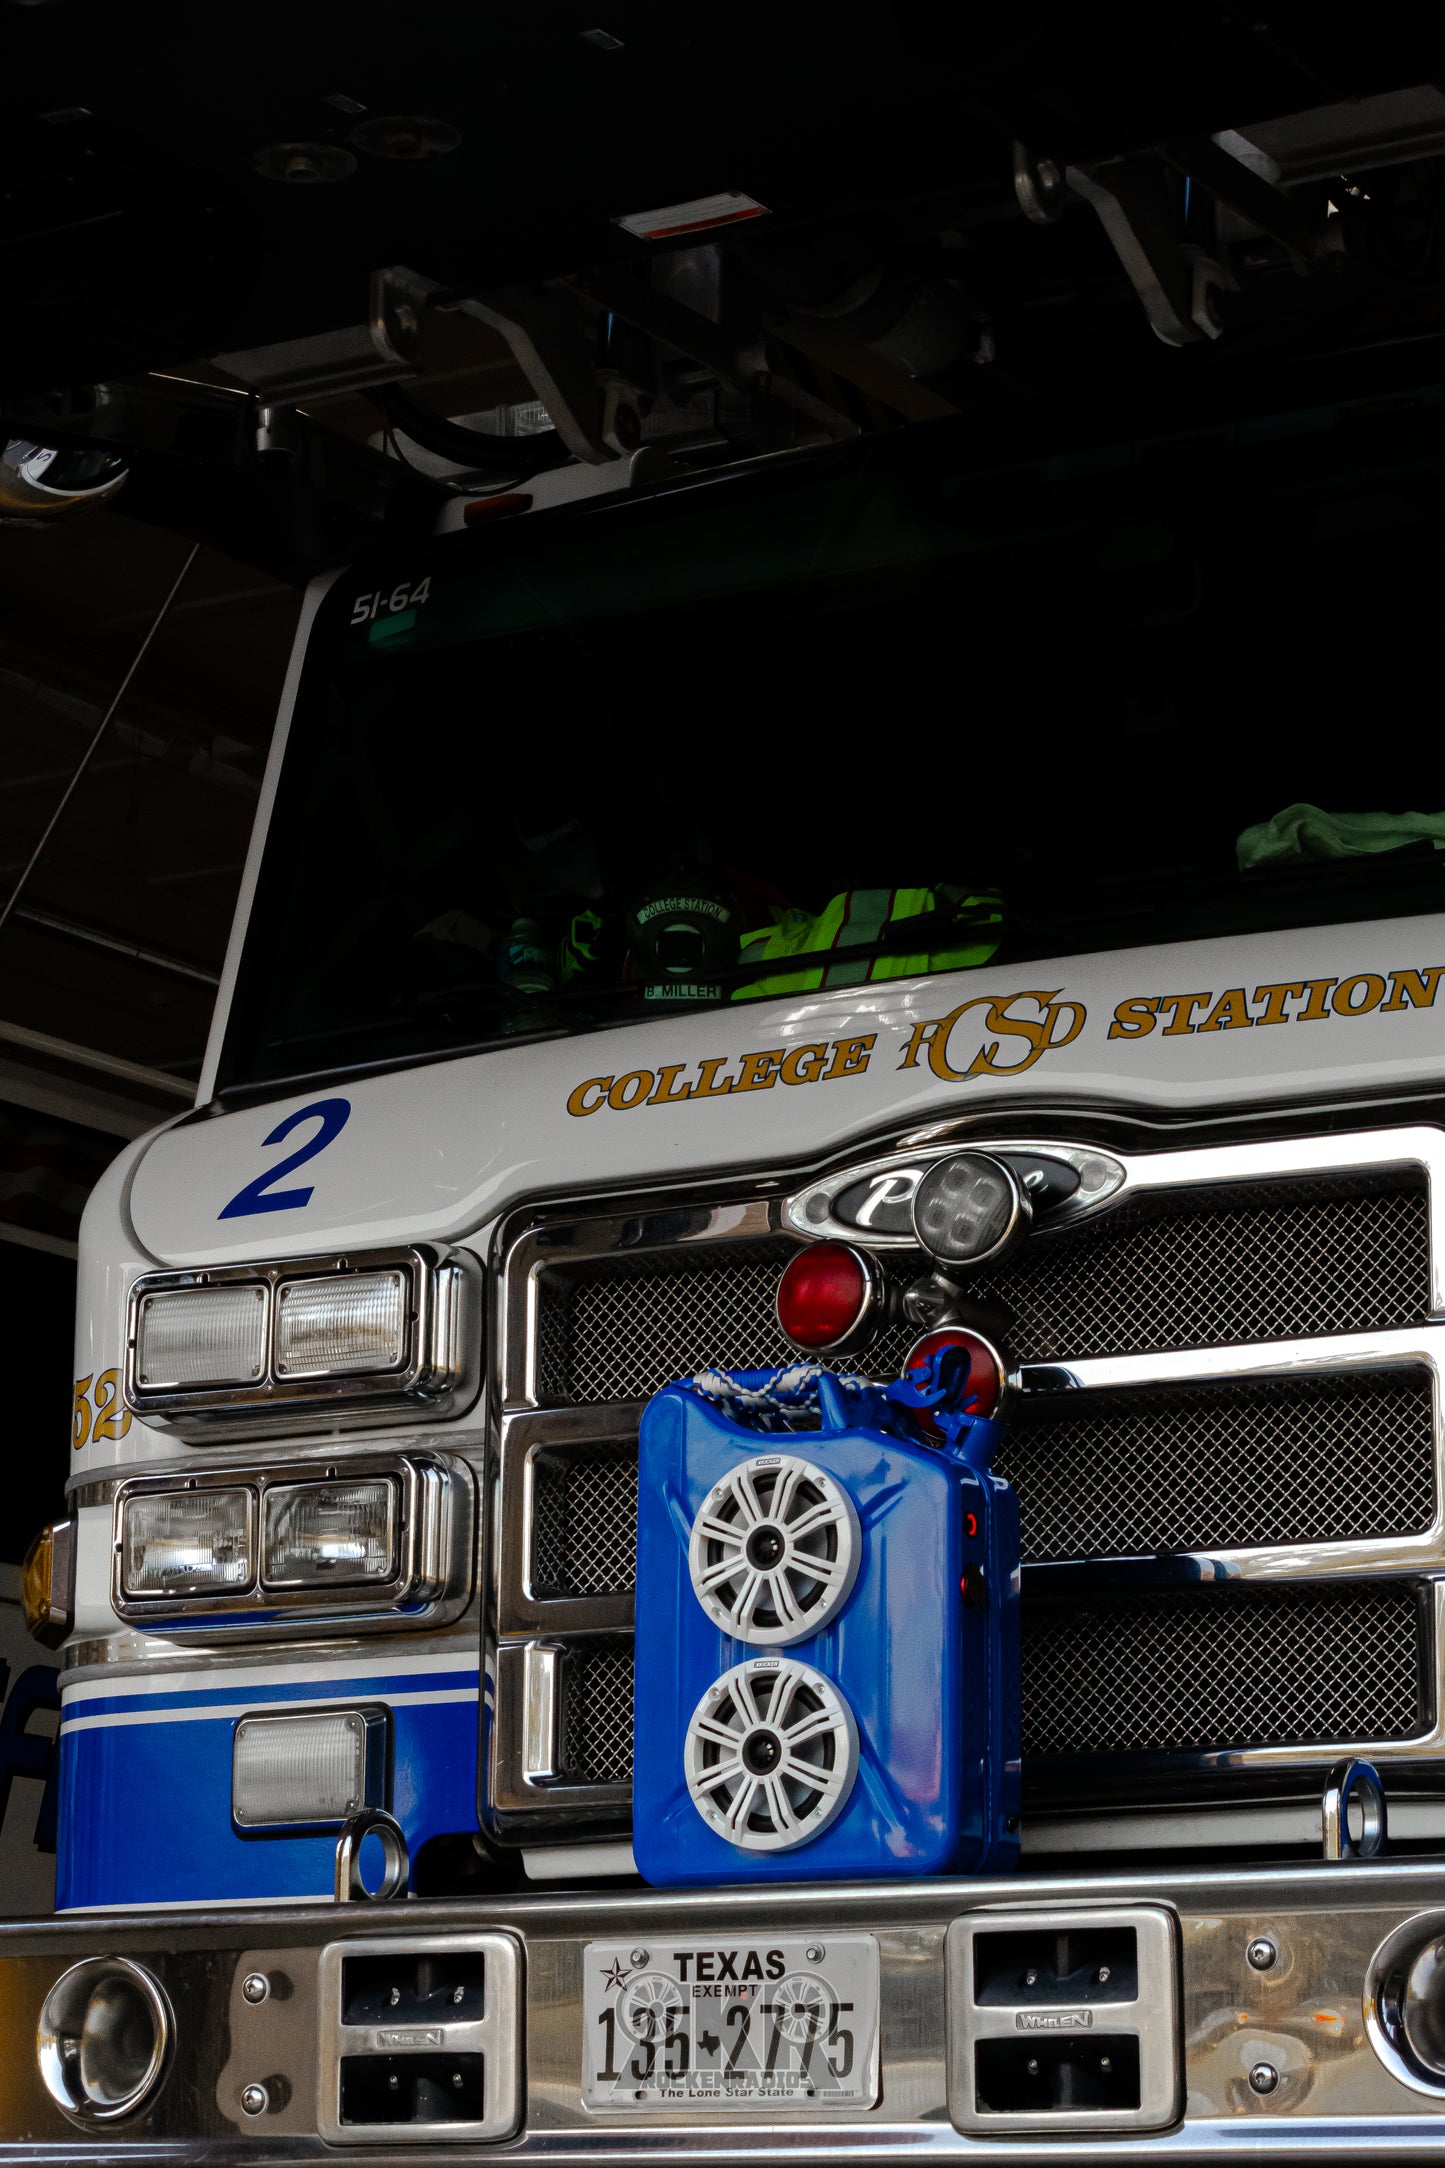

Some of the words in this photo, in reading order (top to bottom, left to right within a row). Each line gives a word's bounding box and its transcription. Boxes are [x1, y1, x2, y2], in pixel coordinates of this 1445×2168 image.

[351, 576, 432, 625] 51-64
[643, 898, 683, 918] COLLEGE
[683, 898, 721, 917] STATION
[662, 984, 716, 997] MILLER
[566, 1033, 878, 1117] COLLEGE
[1107, 966, 1445, 1040] STATION
[217, 1097, 351, 1220] 2
[673, 1950, 786, 1982] TEXAS
[692, 1984, 759, 1998] EXEMPT
[1020, 2011, 1090, 2029] WHELEN
[659, 2088, 684, 2098] The
[688, 2088, 721, 2098] Lone
[725, 2087, 753, 2097] Star
[758, 2086, 794, 2097] State
